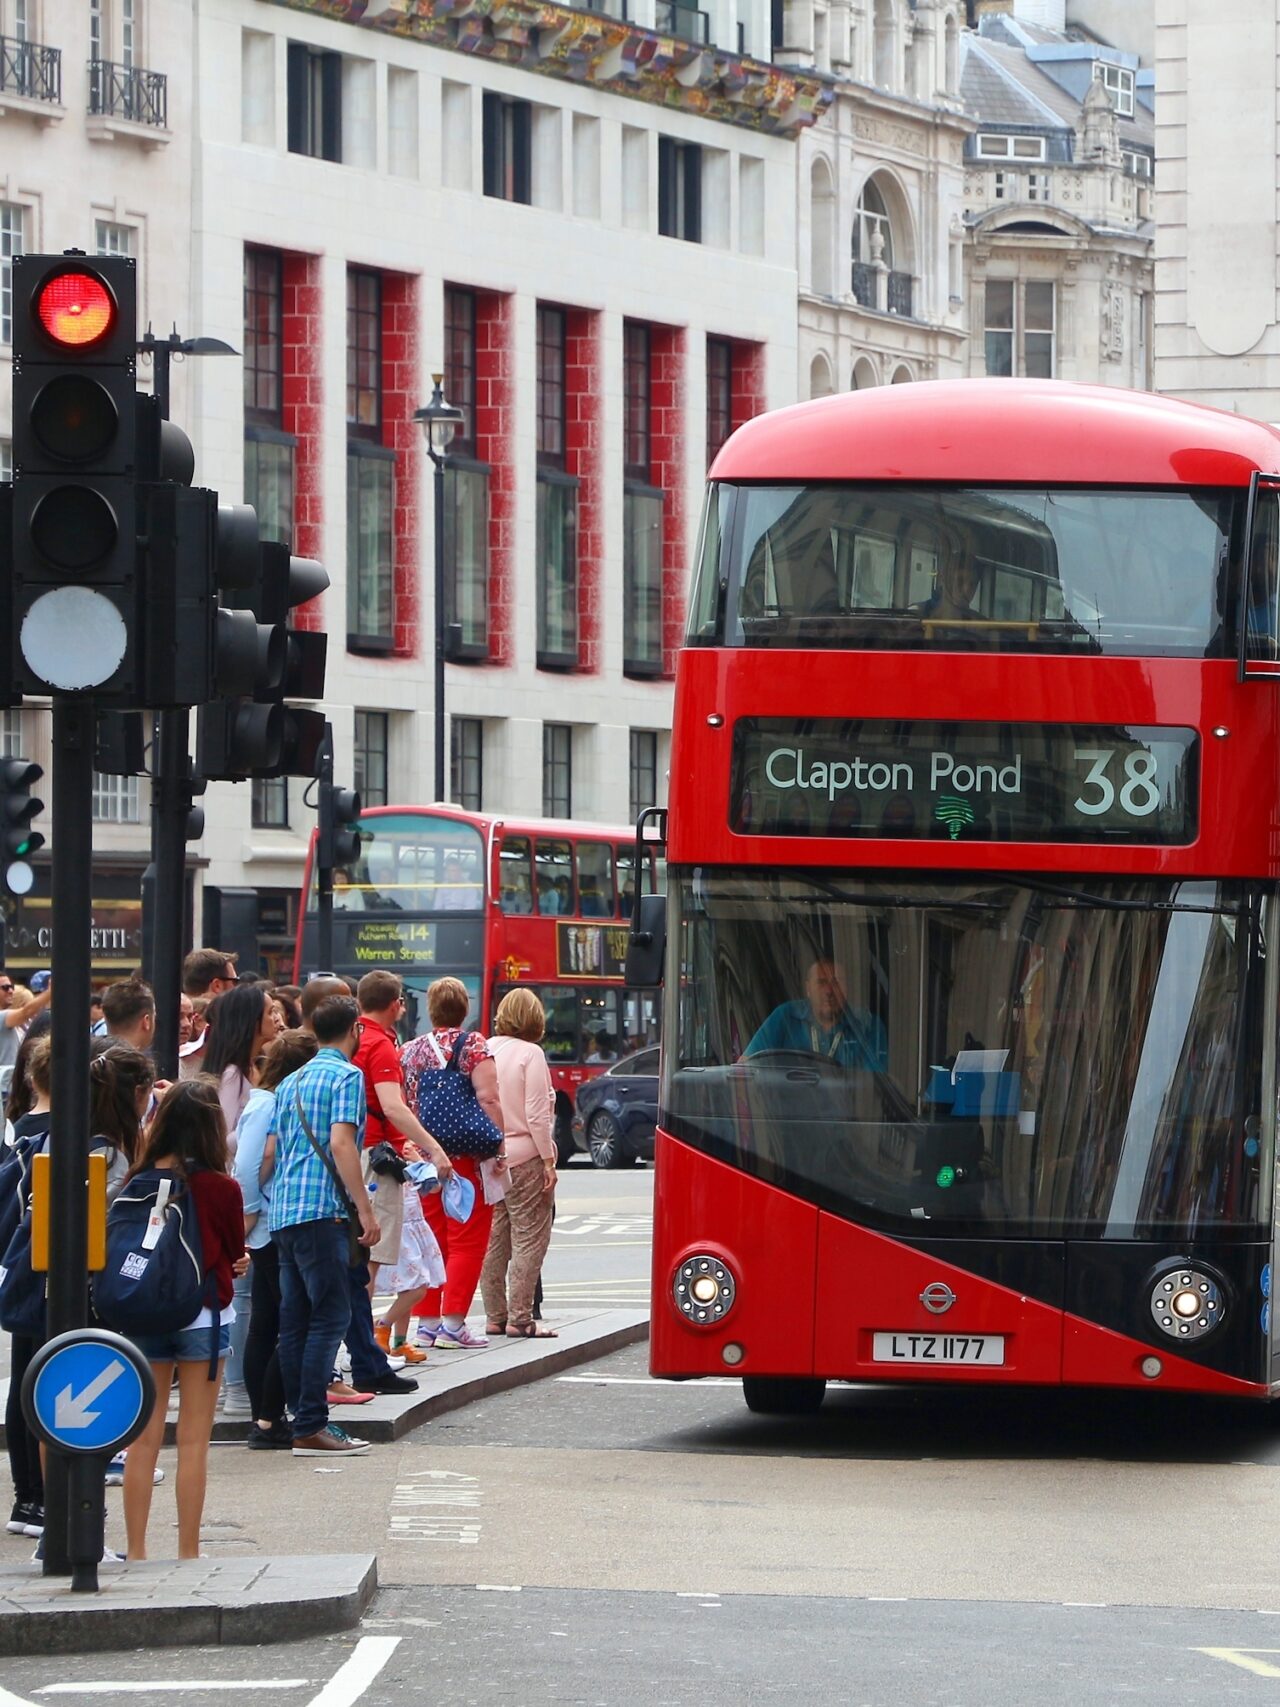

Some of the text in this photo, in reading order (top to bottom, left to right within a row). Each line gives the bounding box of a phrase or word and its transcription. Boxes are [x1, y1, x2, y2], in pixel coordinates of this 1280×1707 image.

[765, 748, 1161, 816] Clapton Pond 38
[410, 923, 429, 940] 14
[355, 946, 433, 960] Warren Street
[892, 1336, 985, 1359] LTZ 1177
[387, 1516, 482, 1544] LEFT
